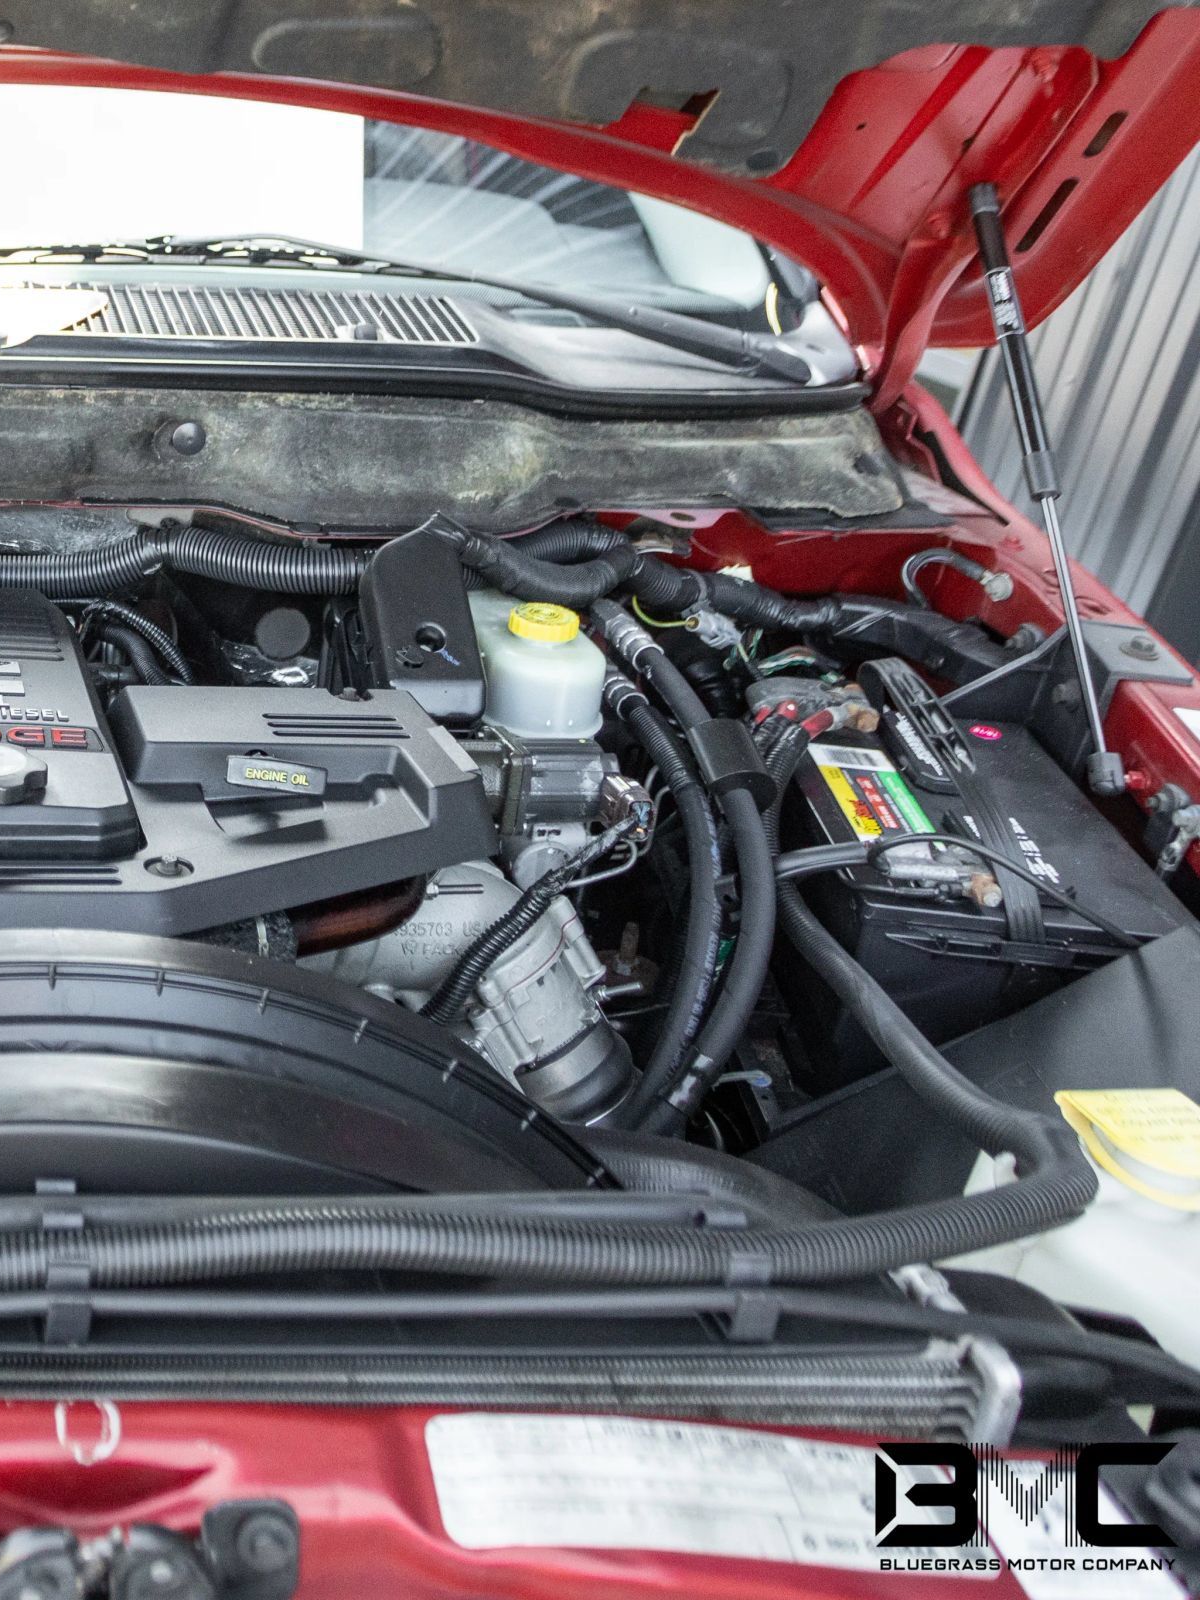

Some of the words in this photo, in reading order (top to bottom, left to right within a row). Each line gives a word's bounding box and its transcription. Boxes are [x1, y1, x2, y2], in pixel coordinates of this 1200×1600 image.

[245, 767, 287, 783] ENGINE
[291, 774, 309, 786] OIL
[393, 921, 453, 937] 935703
